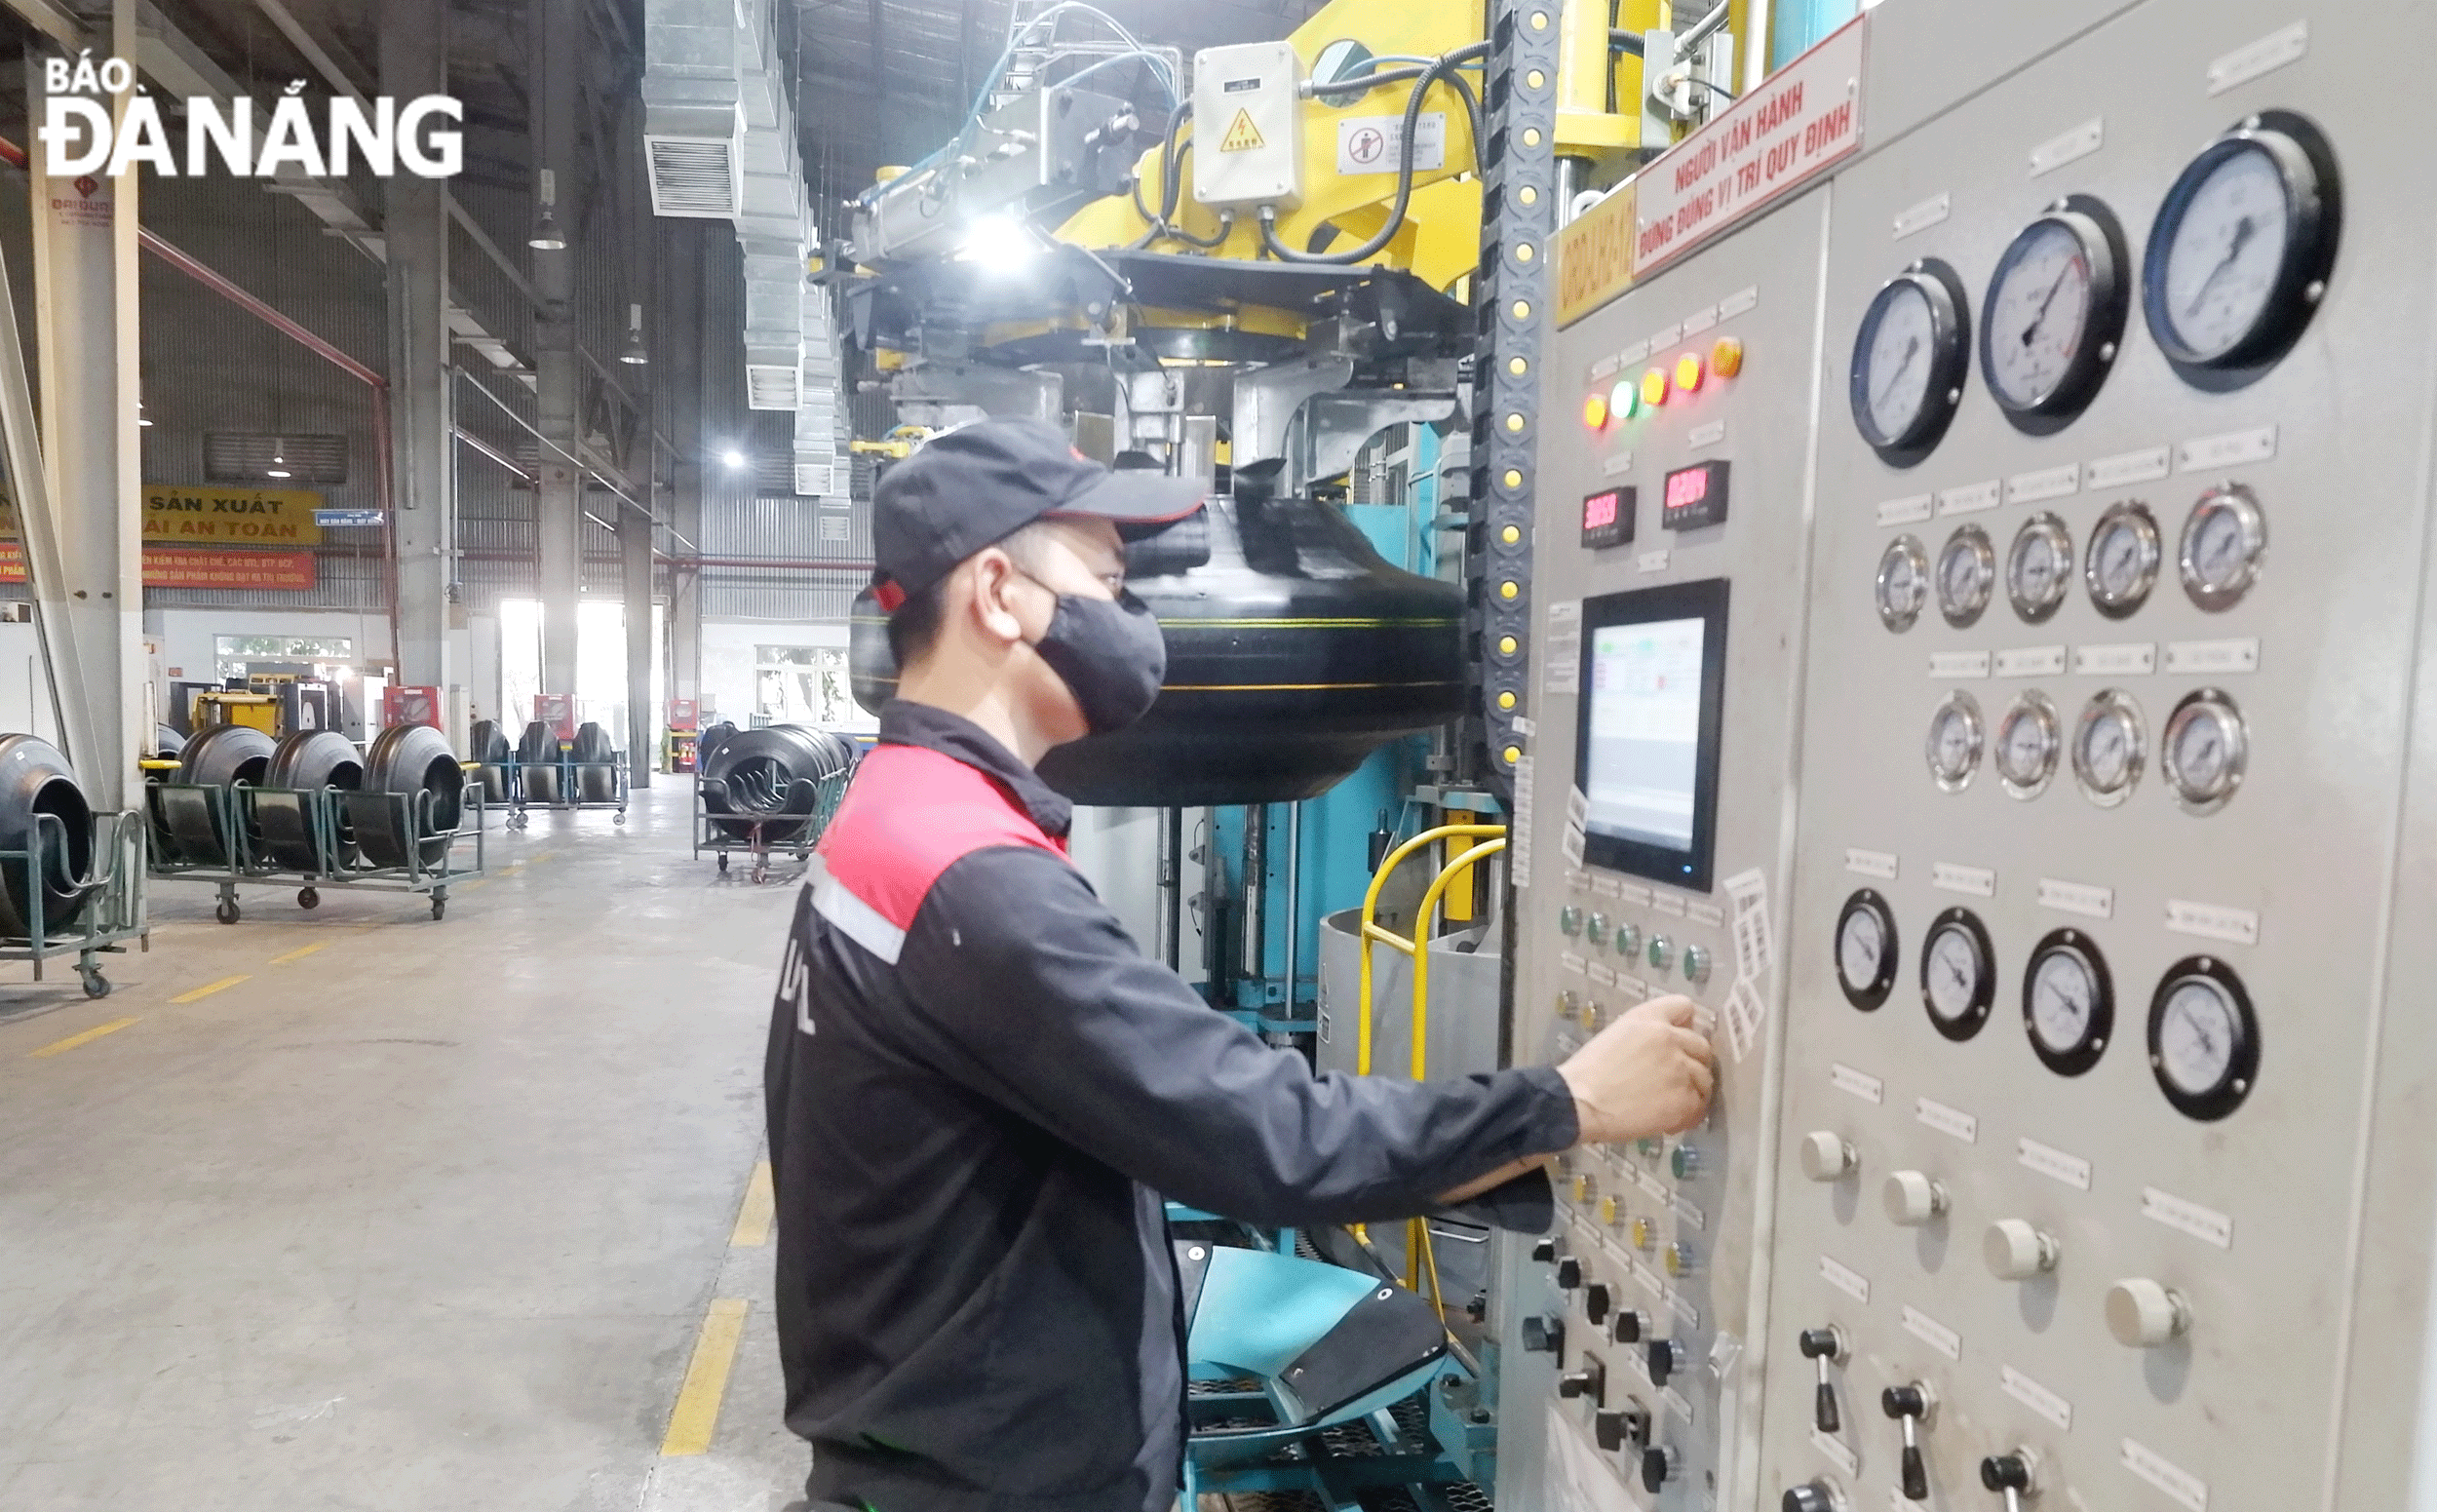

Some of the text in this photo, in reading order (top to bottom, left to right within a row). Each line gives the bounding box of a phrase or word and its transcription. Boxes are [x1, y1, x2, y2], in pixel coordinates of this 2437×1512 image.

[1675, 81, 1803, 195] NGƯỜI VẬN HÀNH
[1718, 175, 1732, 212] VỊ
[1737, 148, 1761, 197] TRÍ
[1765, 132, 1800, 181] QUY
[1804, 99, 1851, 159] ĐỊNH
[149, 490, 284, 515] SẢN XUẤT
[180, 520, 216, 535] AN
